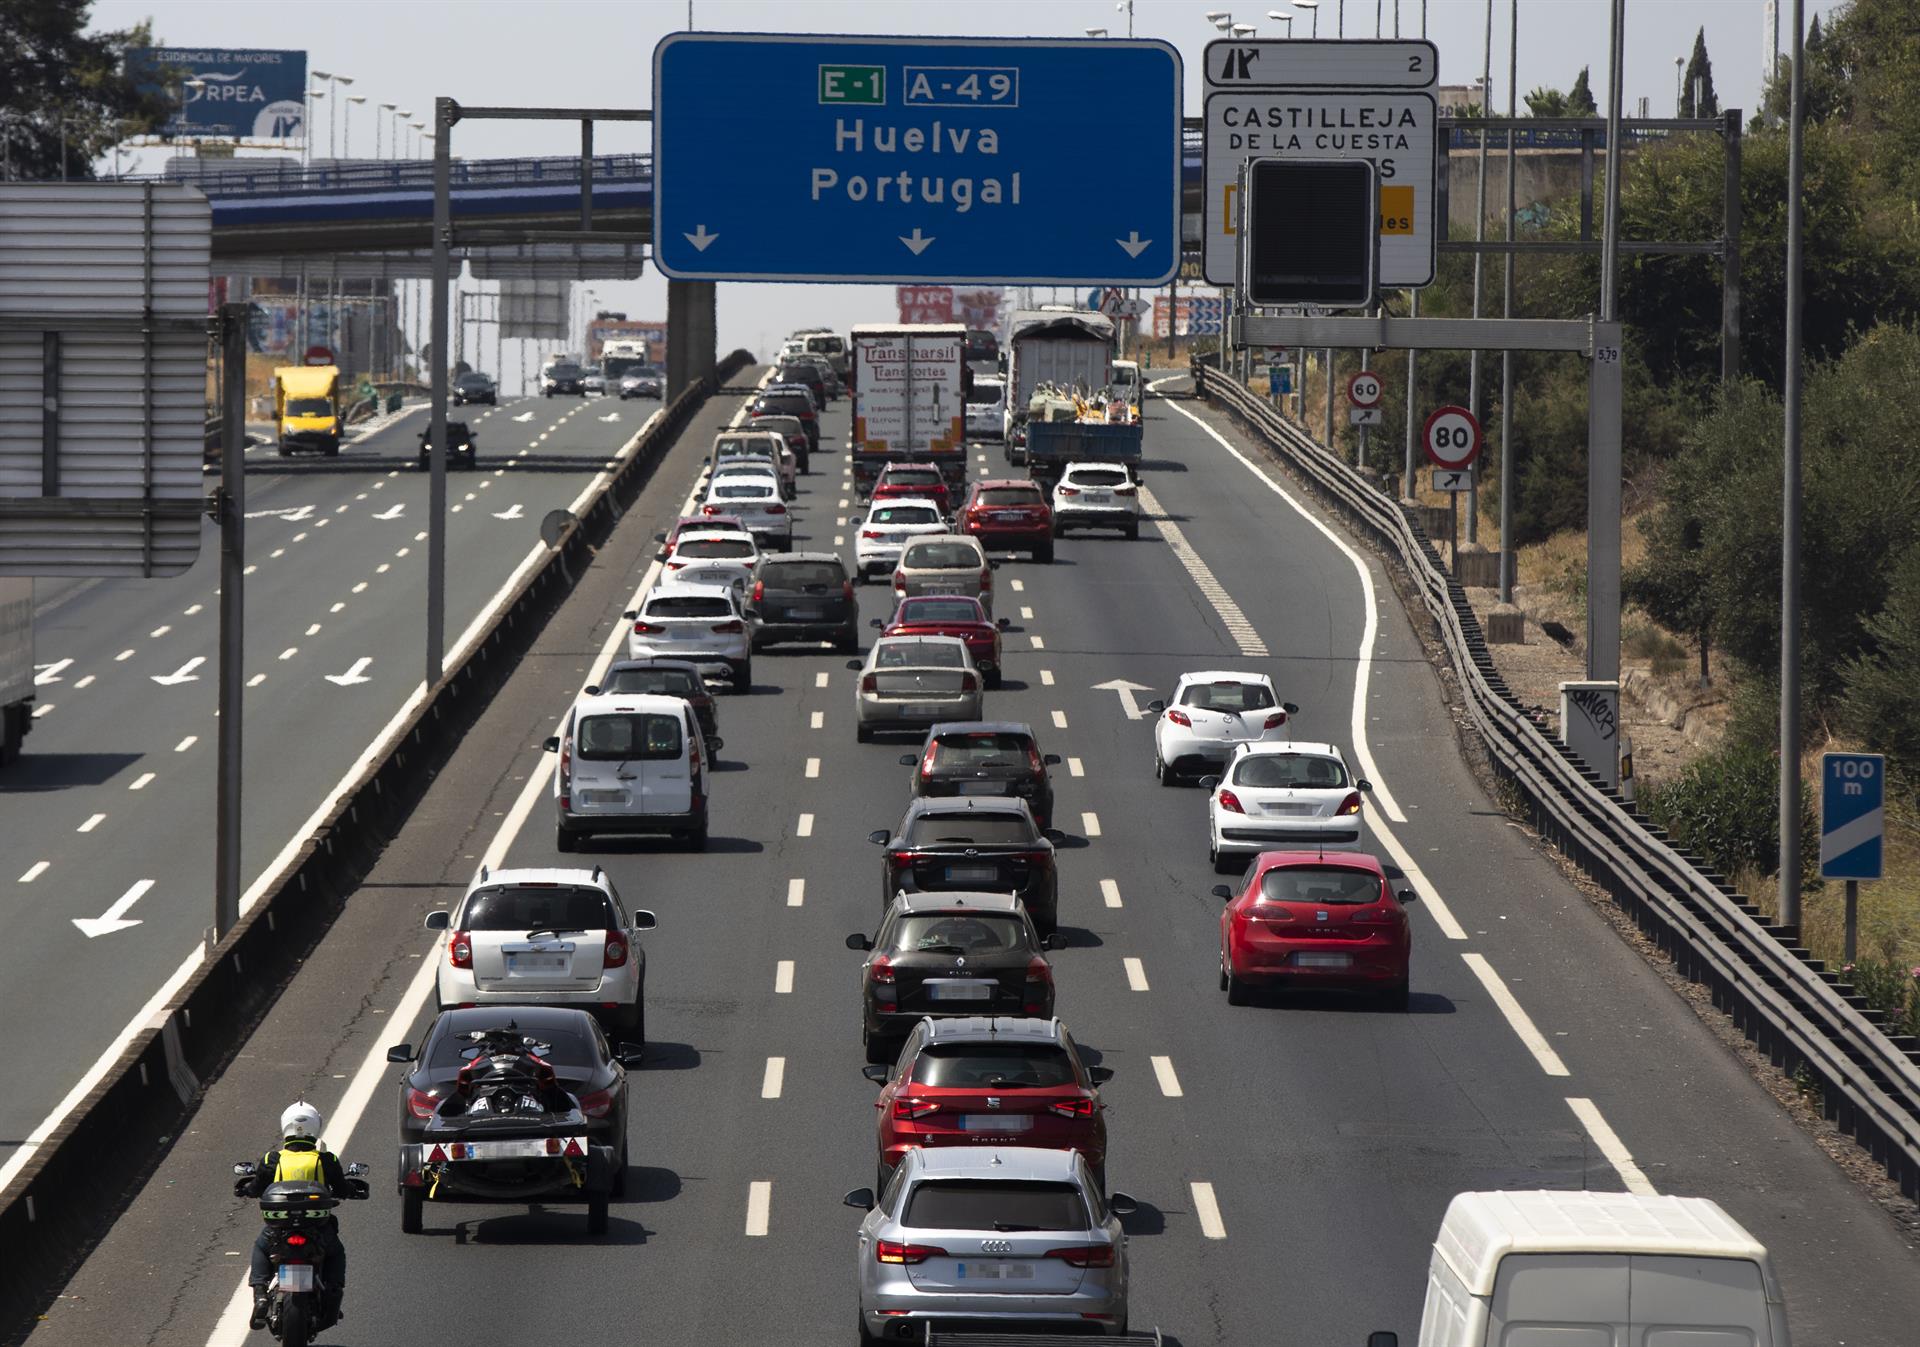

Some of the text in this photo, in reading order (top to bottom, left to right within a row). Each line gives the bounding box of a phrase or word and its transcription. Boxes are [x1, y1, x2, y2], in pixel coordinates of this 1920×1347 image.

[157, 52, 213, 63] ESIDENCIA
[1408, 56, 1422, 72] 2
[824, 71, 879, 98] E-1
[908, 73, 1011, 100] A-49
[1223, 107, 1416, 128] CASTILLEJA
[836, 119, 998, 153] Huelva
[1230, 133, 1409, 150] DE LA CUESTA
[812, 168, 1020, 213] Portugal
[1598, 350, 1617, 360] 5.79
[1355, 384, 1377, 396] 60
[1435, 427, 1468, 448] 80
[1833, 761, 1874, 778] 100
[1844, 782, 1862, 795] m
